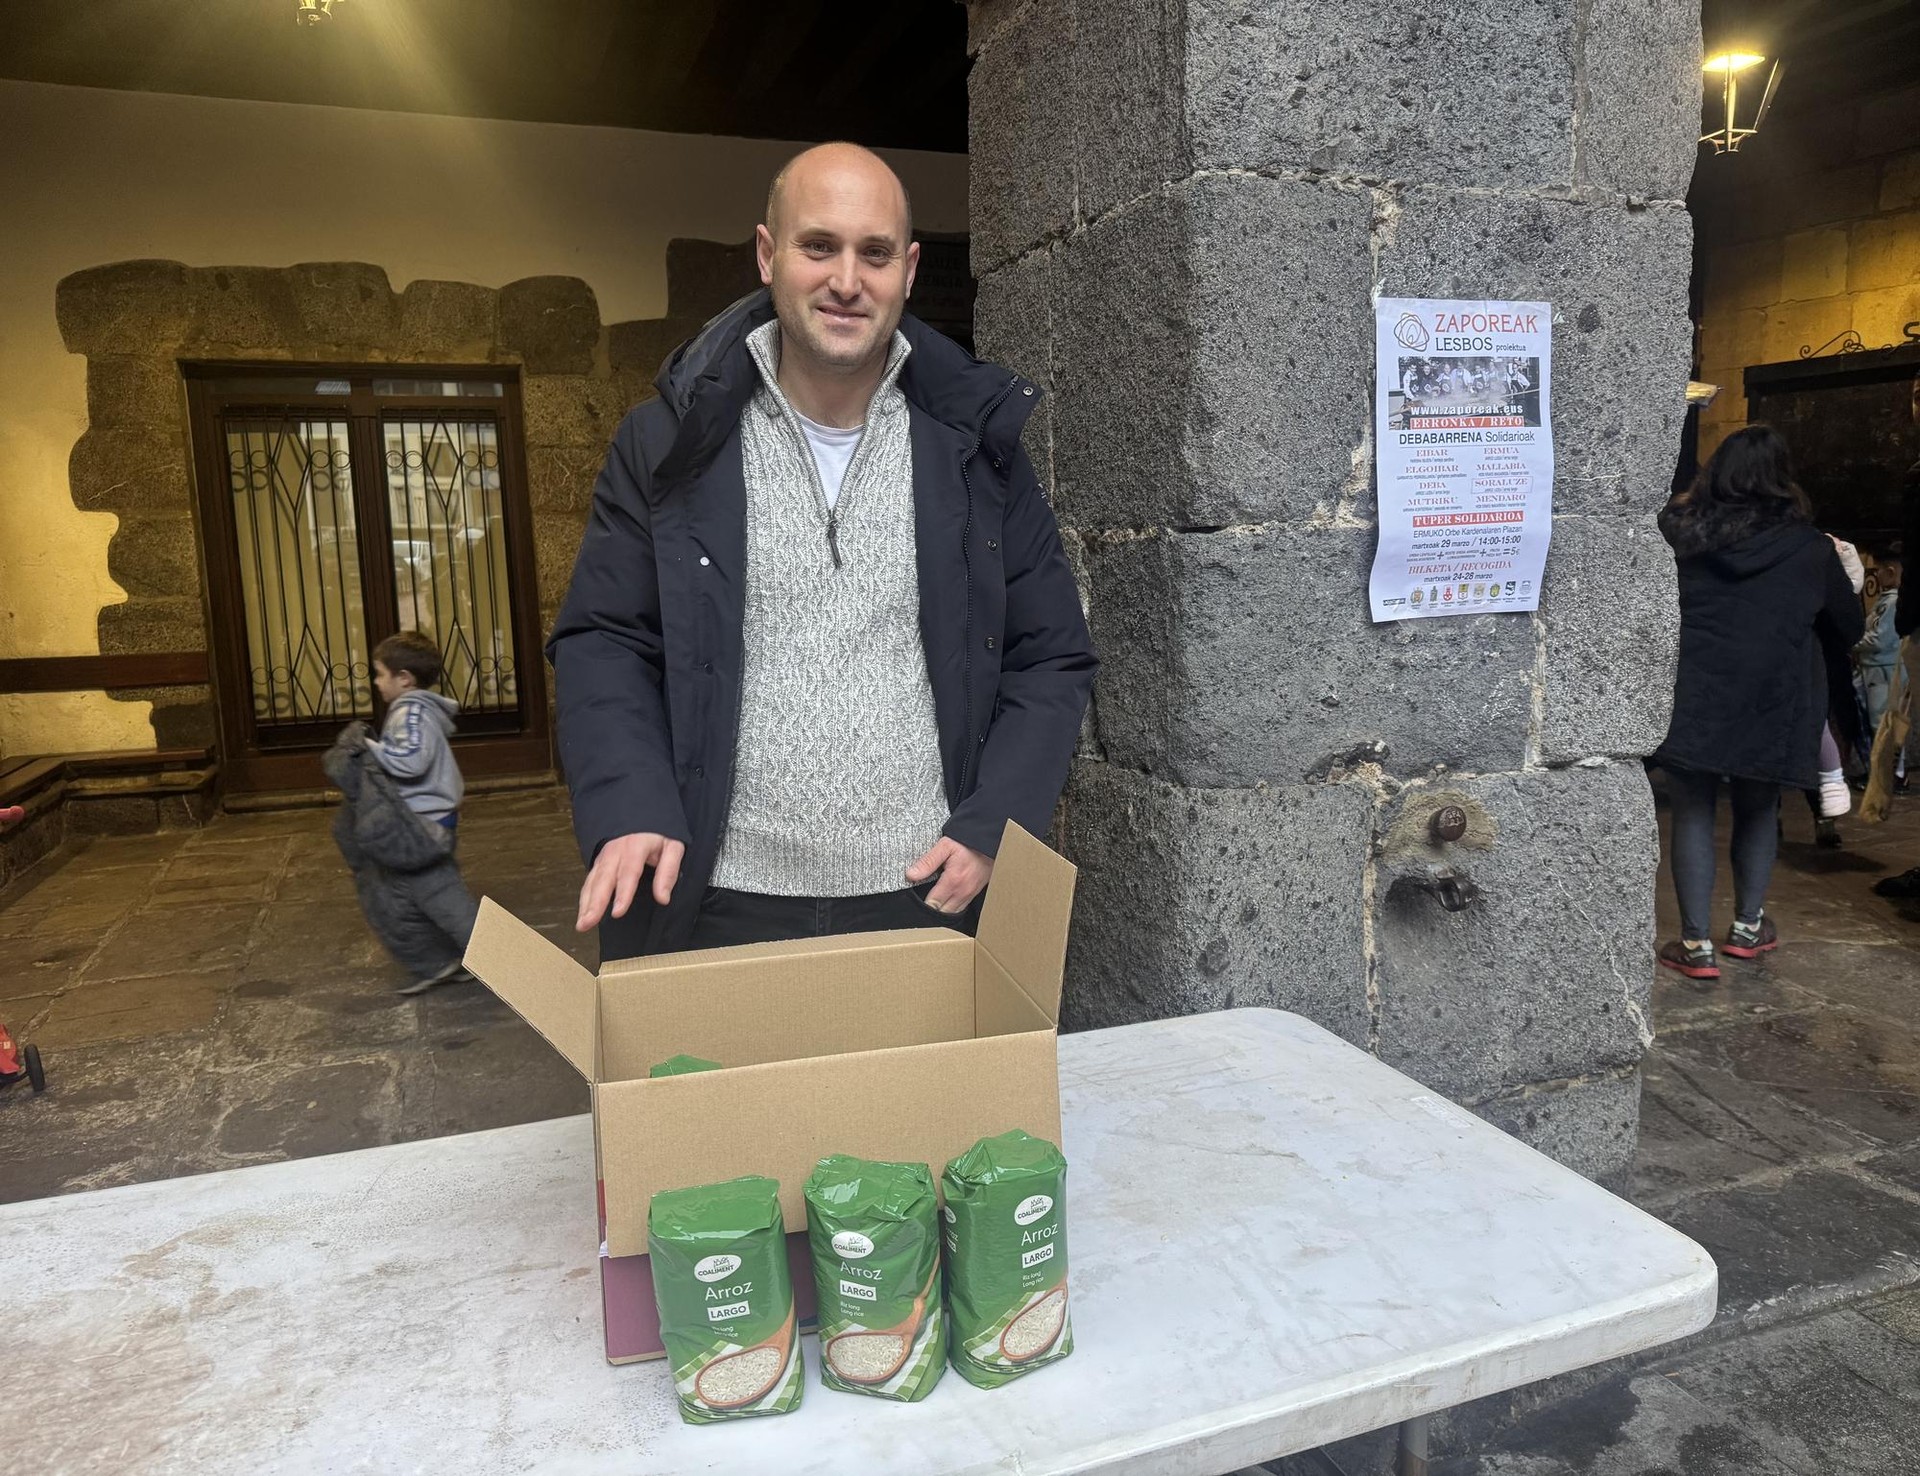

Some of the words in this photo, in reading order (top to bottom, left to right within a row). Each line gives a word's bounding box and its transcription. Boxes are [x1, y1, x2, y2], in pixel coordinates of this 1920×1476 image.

[1435, 314, 1537, 333] ZAPOREAK
[1436, 338, 1492, 351] LESBOS
[1411, 404, 1523, 416] www.zaporeak.eus
[1412, 418, 1474, 428] ERRONKA
[1490, 416, 1522, 426] RETO
[1400, 434, 1482, 444] DEBABARRENA
[1486, 431, 1535, 442] Solidarioak
[1416, 449, 1448, 457] EIBAR
[1406, 465, 1459, 474] ELGOIBAR
[1476, 463, 1526, 471] MALLABIA
[1475, 478, 1528, 487] SORALUZE
[1408, 497, 1458, 506] MUTRIKU
[1476, 495, 1526, 503] MENDARO
[1415, 515, 1451, 526] TUPER
[1455, 512, 1522, 523] SOLIDARIOA
[1414, 529, 1443, 538] ERMUKO
[1441, 540, 1450, 548] 29
[1479, 536, 1521, 545] 14:00-15:00
[1409, 564, 1450, 574] BILKETA
[1460, 561, 1512, 571] RECOGIDA
[1018, 1206, 1047, 1219] COALIMENT
[1021, 1223, 1058, 1246] Arroz
[834, 1244, 866, 1253] COALIMENT
[1024, 1248, 1052, 1264] LARGO
[698, 1265, 734, 1276] COALIMENT
[841, 1261, 882, 1280] Arroz
[705, 1282, 753, 1301] Arroz
[842, 1284, 874, 1297] LARGO
[710, 1305, 746, 1318] LARGO
